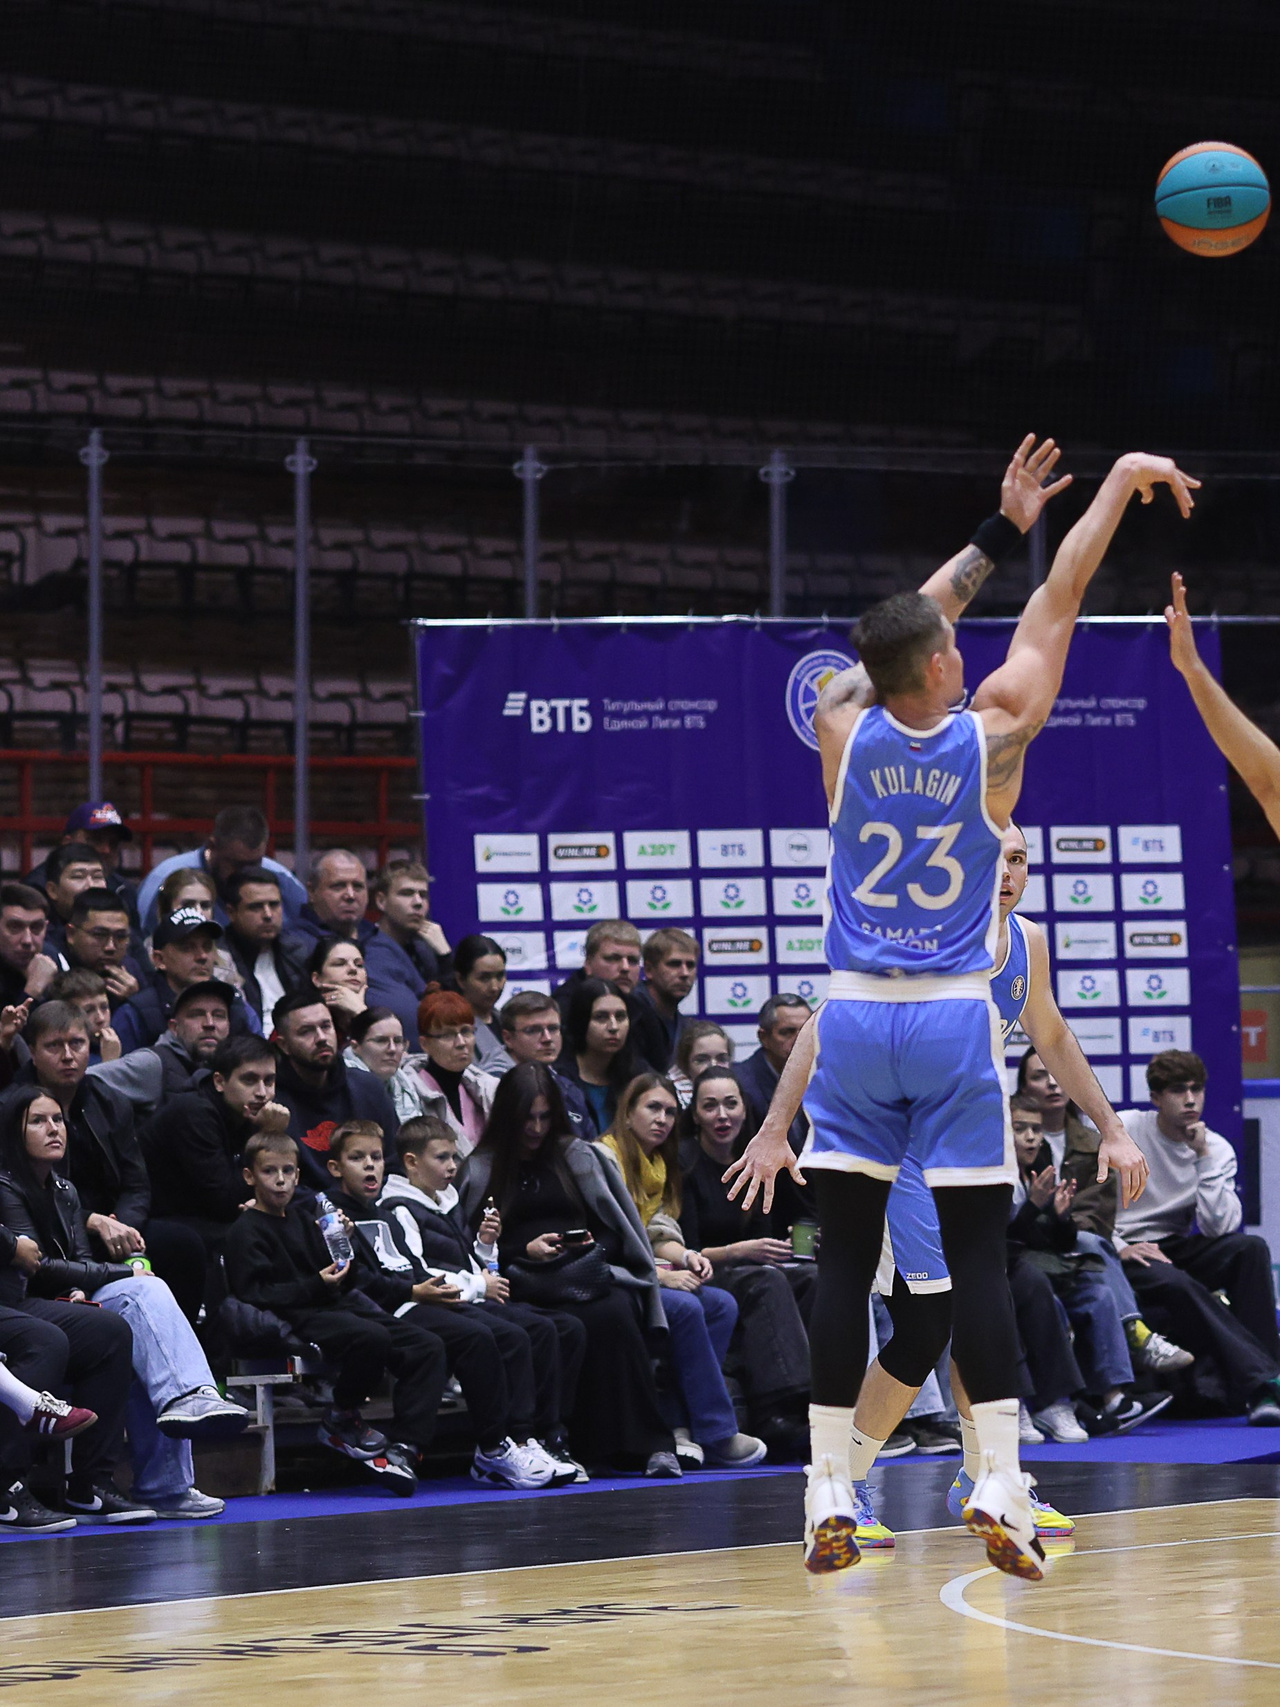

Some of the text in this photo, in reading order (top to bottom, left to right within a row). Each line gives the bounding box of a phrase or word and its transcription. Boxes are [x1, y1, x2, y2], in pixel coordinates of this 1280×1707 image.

[530, 699, 592, 733] ВТБ
[602, 697, 718, 712] Титульный спонсор
[603, 715, 706, 731] Единой Лиги ВТБ
[1114, 713, 1136, 726] ВТБ
[870, 764, 962, 806] KULAGIN
[851, 821, 965, 910] 23
